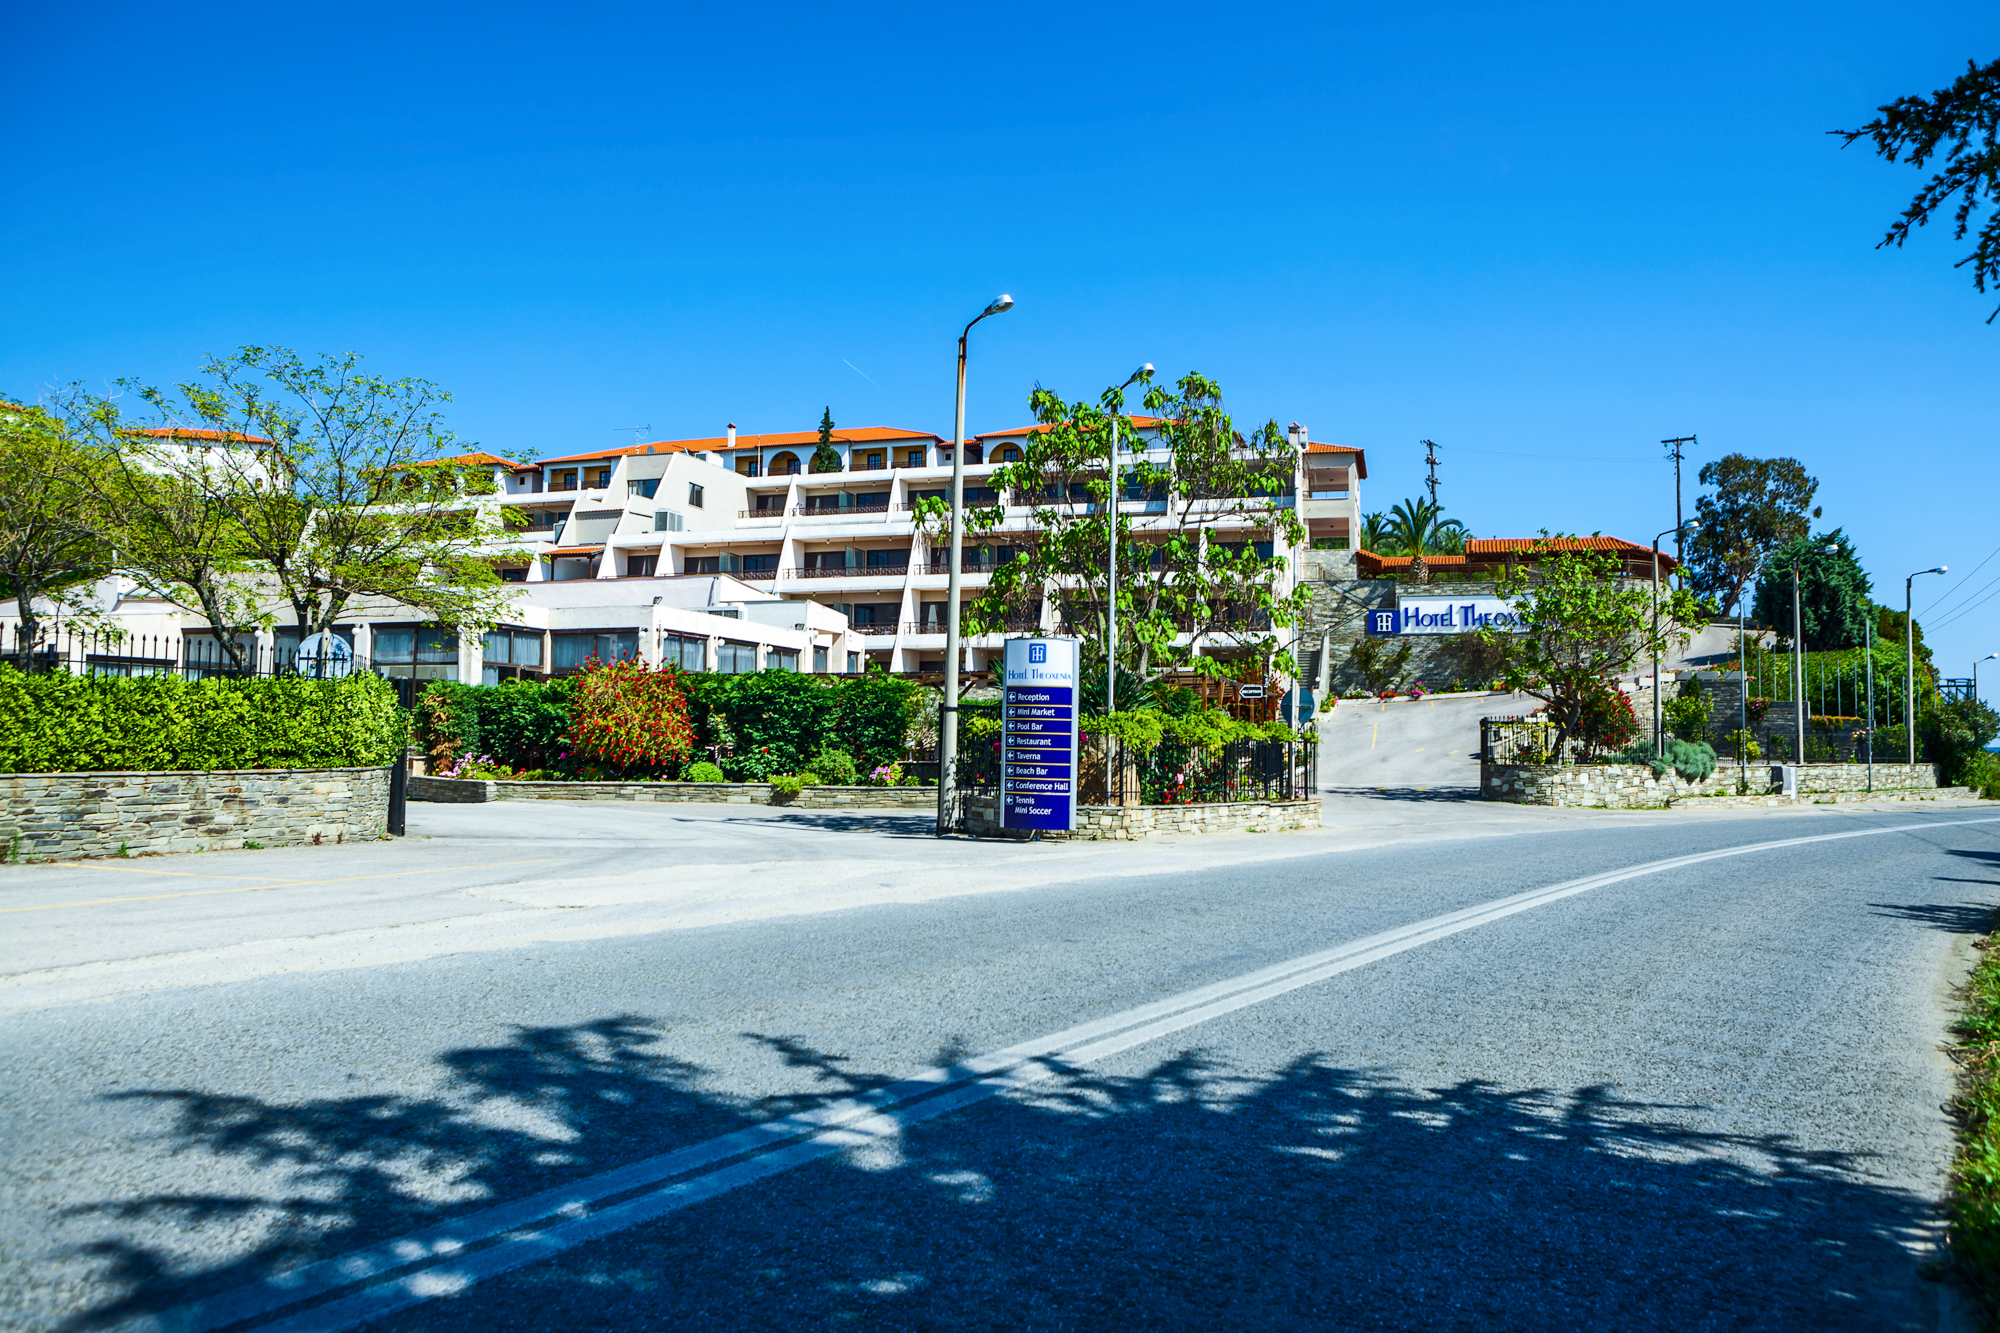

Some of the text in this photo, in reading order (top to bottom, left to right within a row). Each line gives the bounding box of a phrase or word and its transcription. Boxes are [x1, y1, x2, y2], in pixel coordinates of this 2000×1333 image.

[1017, 693, 1050, 702] Reception
[1031, 708, 1055, 716] Market
[1016, 737, 1051, 746] Restaurant
[1016, 752, 1041, 760] Taverna
[1016, 766, 1048, 775] Beach Bar
[1015, 781, 1069, 791] Conference Hall
[1015, 795, 1035, 804] Tennis
[1014, 806, 1052, 815] Mini Soccer
